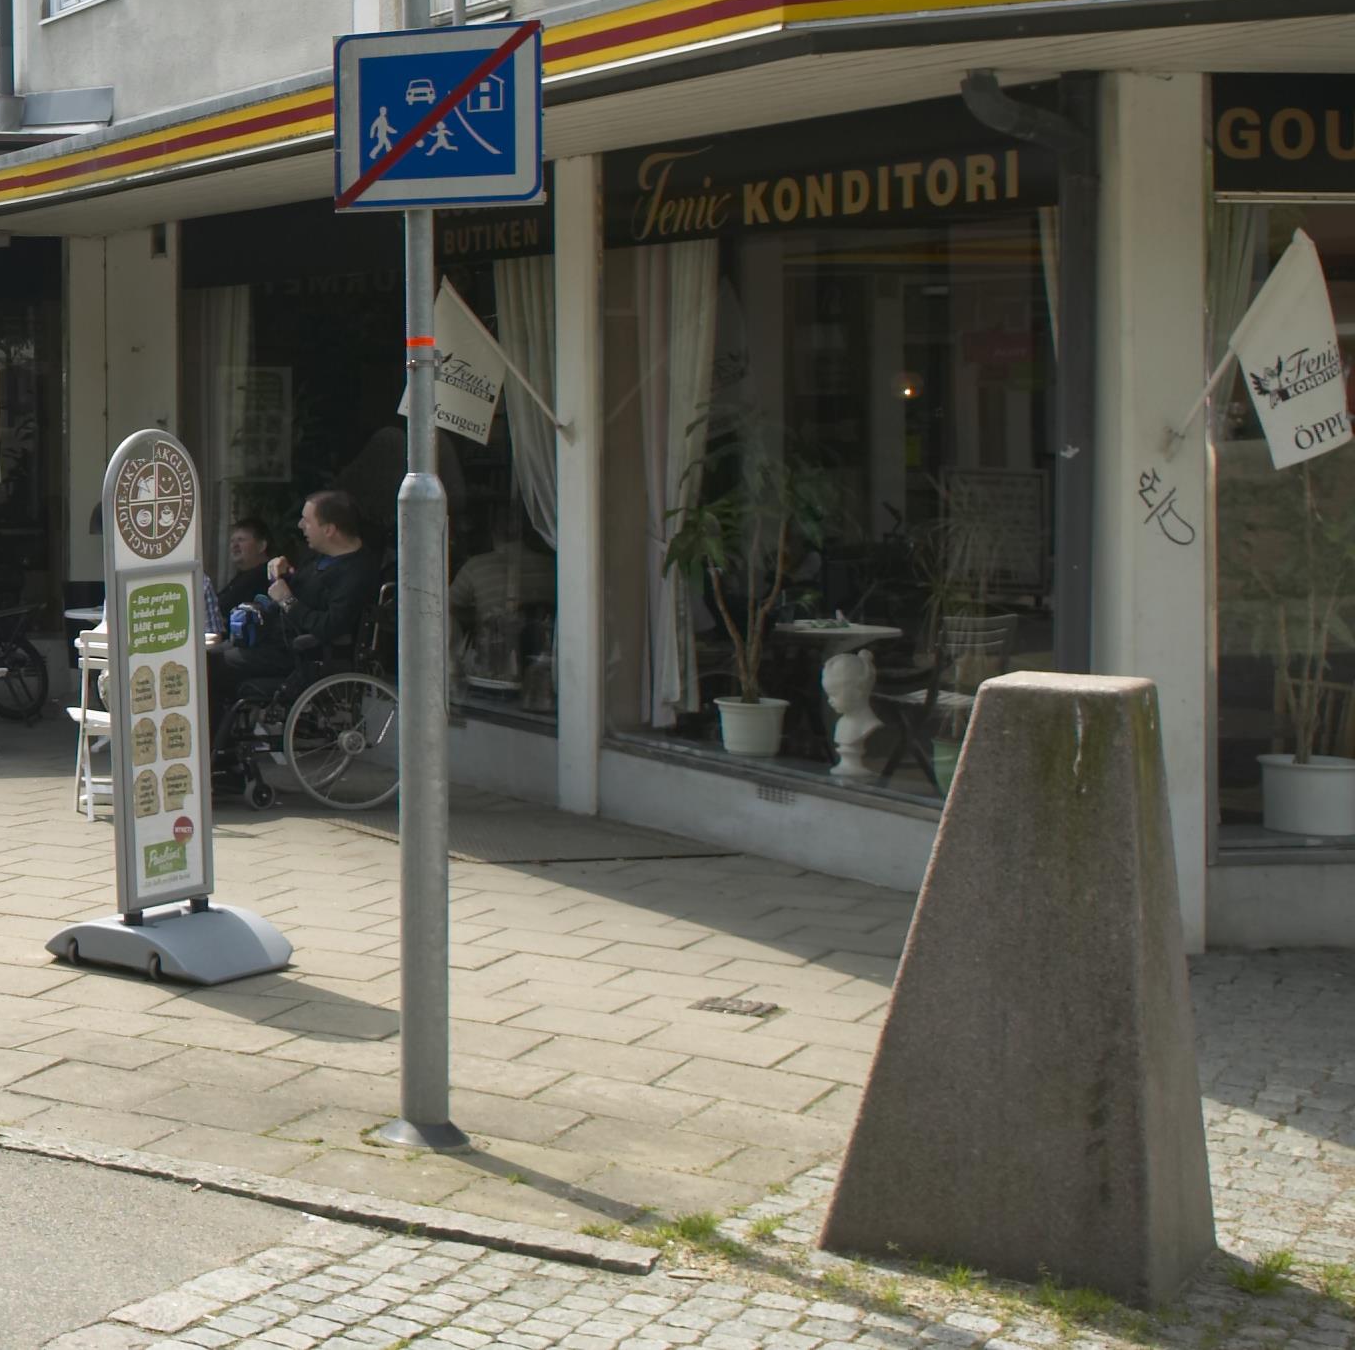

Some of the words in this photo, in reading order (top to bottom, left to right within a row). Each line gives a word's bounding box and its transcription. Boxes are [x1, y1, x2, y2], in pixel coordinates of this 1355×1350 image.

[1217, 106, 1355, 161] GOU
[631, 143, 732, 242] Fenix
[742, 149, 1021, 226] KONDITORI
[442, 217, 540, 255] BUTIKEN
[435, 403, 487, 437] fesugen?
